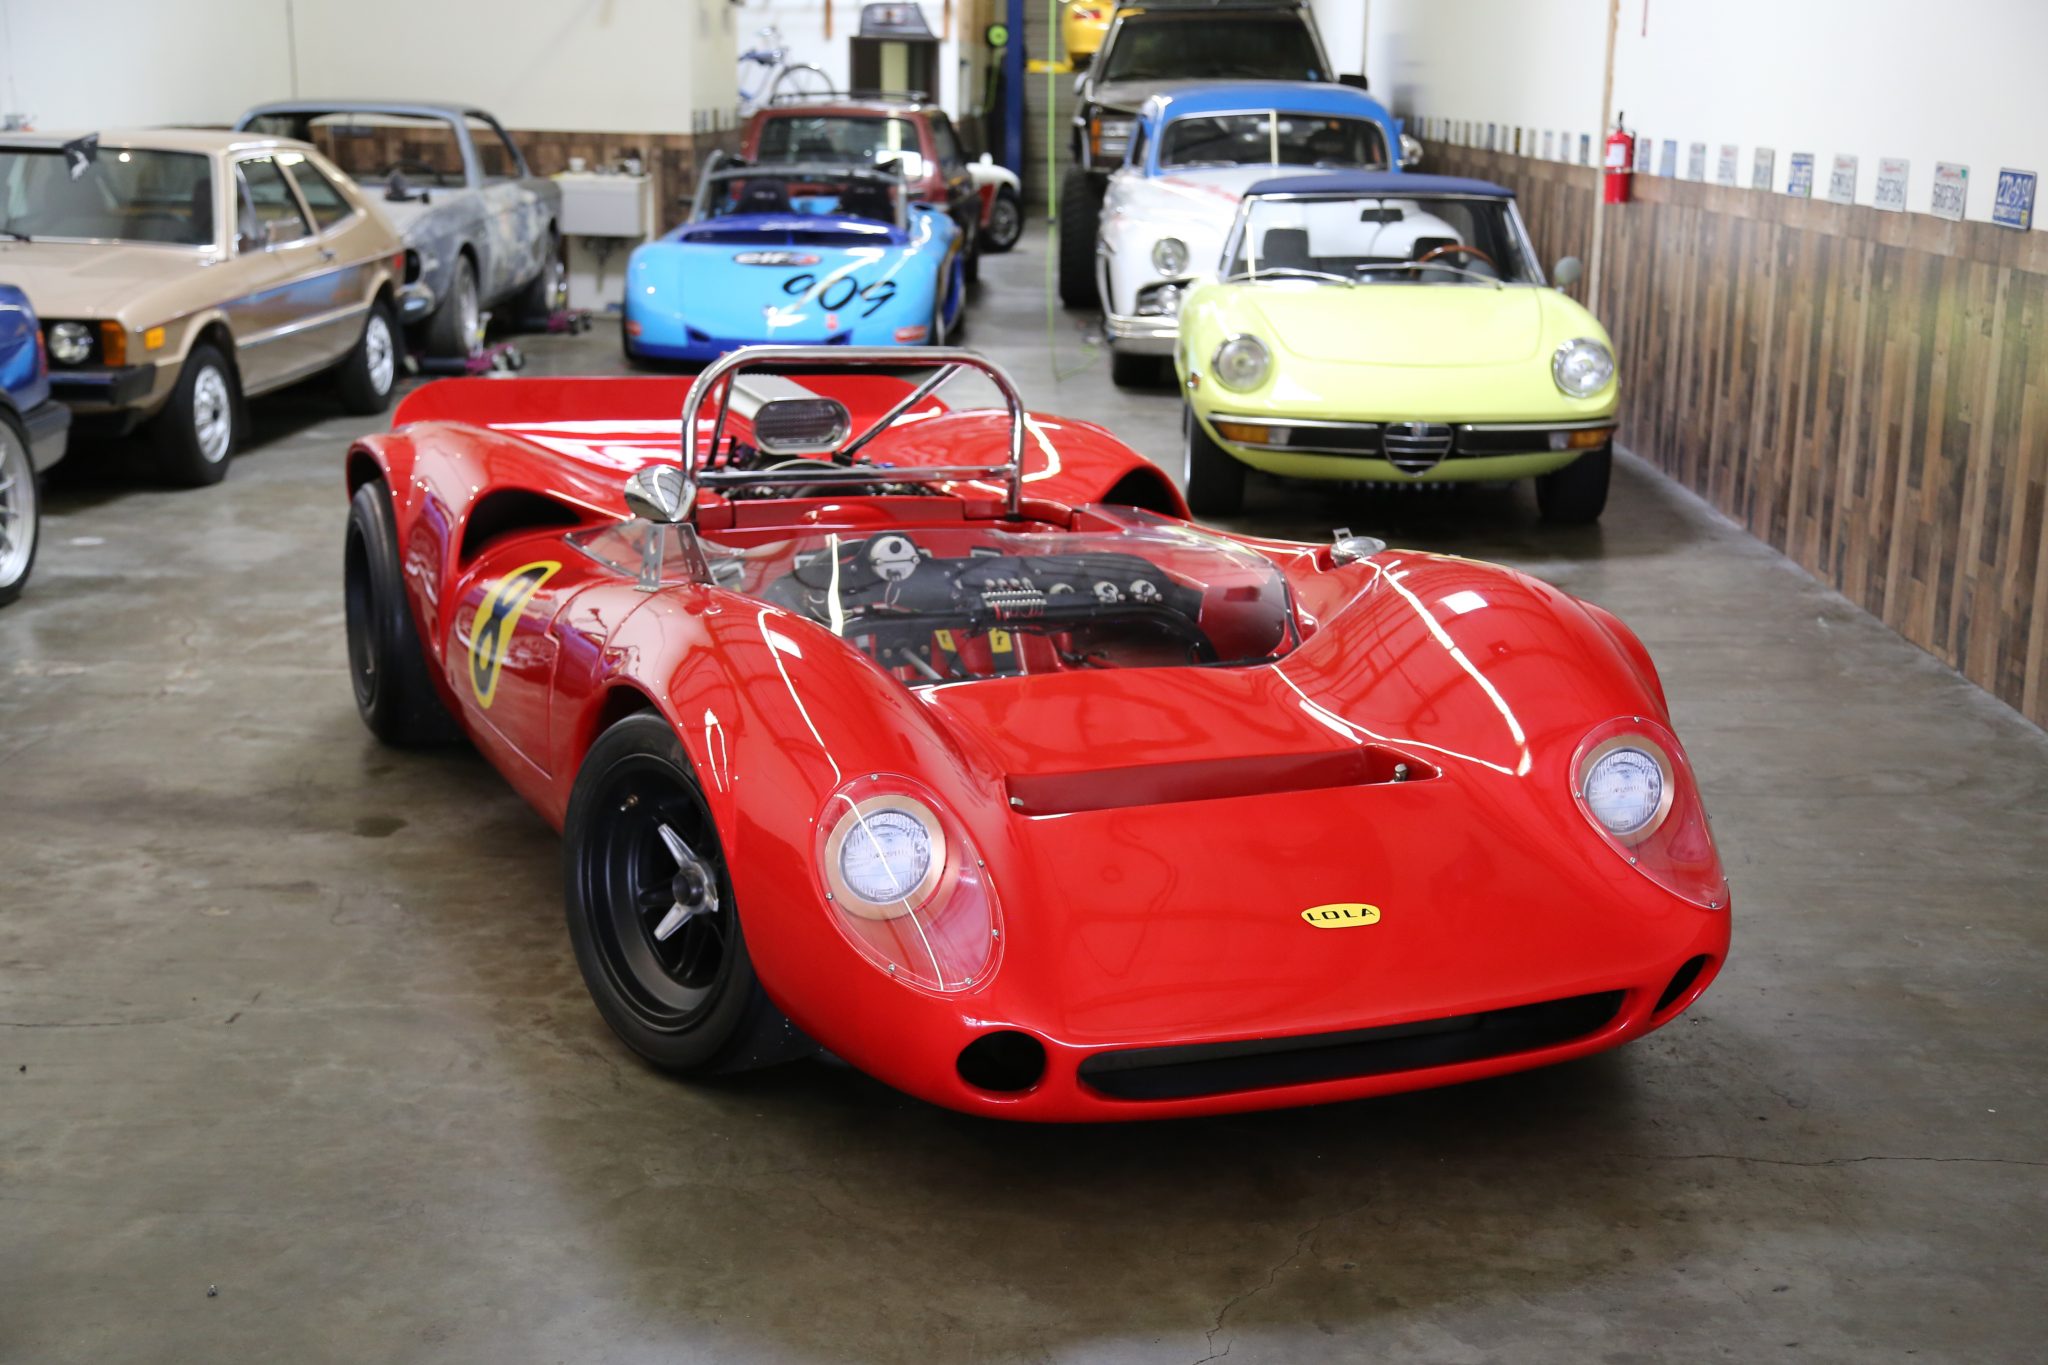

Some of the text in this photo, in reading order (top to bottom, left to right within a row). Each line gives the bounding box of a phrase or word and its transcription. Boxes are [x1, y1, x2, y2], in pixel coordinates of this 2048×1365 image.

[783, 274, 897, 318] 909
[470, 563, 557, 703] 8
[1306, 908, 1375, 921] LOLA
